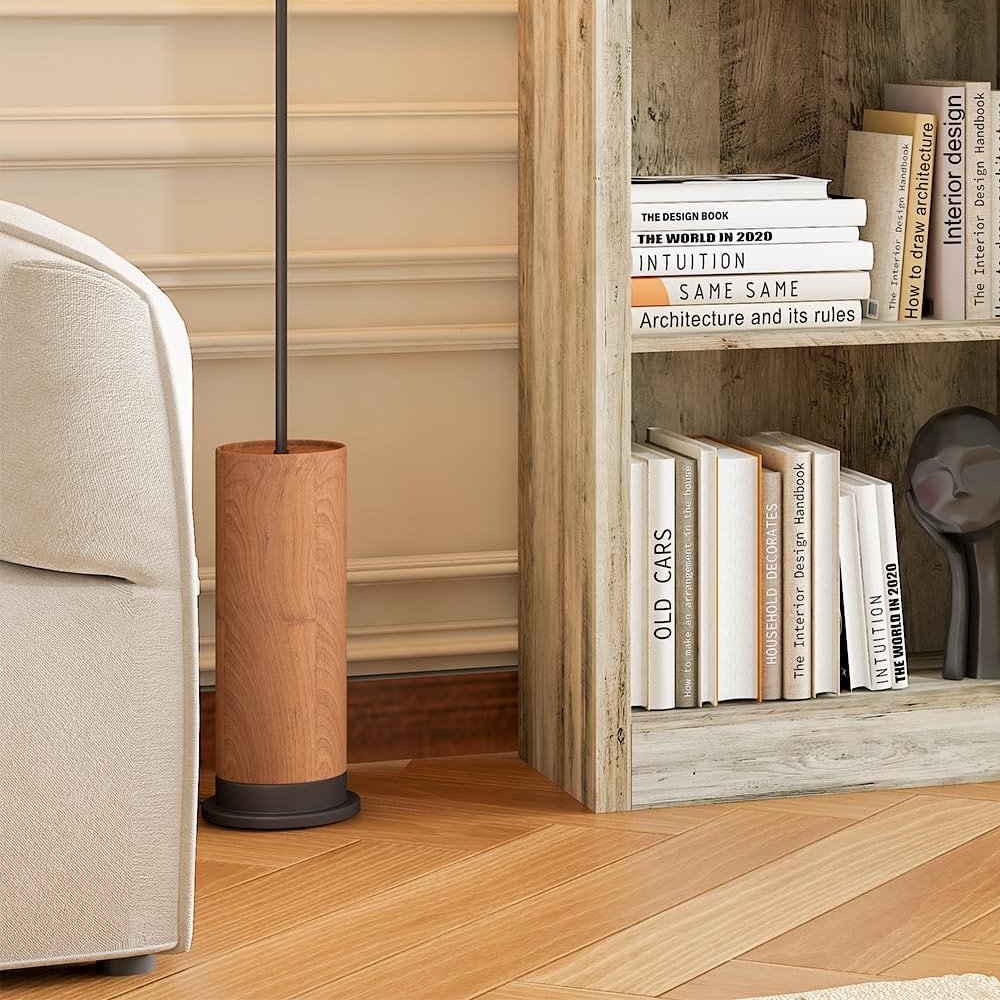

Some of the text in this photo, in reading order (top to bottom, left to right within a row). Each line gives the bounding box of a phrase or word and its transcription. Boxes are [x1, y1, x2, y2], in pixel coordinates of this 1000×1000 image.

[900, 143, 910, 191] Handbook
[943, 94, 965, 245] Interior design
[641, 212, 729, 221] THE DESIGN BOOK
[895, 197, 905, 232] Design
[905, 122, 933, 319] How to draw architecture
[974, 91, 987, 306] The Interior Design Handbook
[638, 231, 772, 244] THE WORLD IN 2020
[640, 253, 744, 271] INTUITION
[891, 240, 902, 286] Interior
[680, 280, 799, 300] SAME SAME
[640, 307, 855, 328] Architecture and its rules
[684, 524, 691, 536] in
[654, 528, 671, 640] OLD CARS
[684, 543, 693, 608] arrangement
[766, 503, 777, 665] HOUSEHOLD DECORATES
[794, 463, 807, 679] The Interior Design Handbook
[686, 613, 691, 626] an
[869, 595, 888, 684] INTUITION
[885, 563, 905, 683] THE WORLD IN 2020
[685, 659, 691, 672] to
